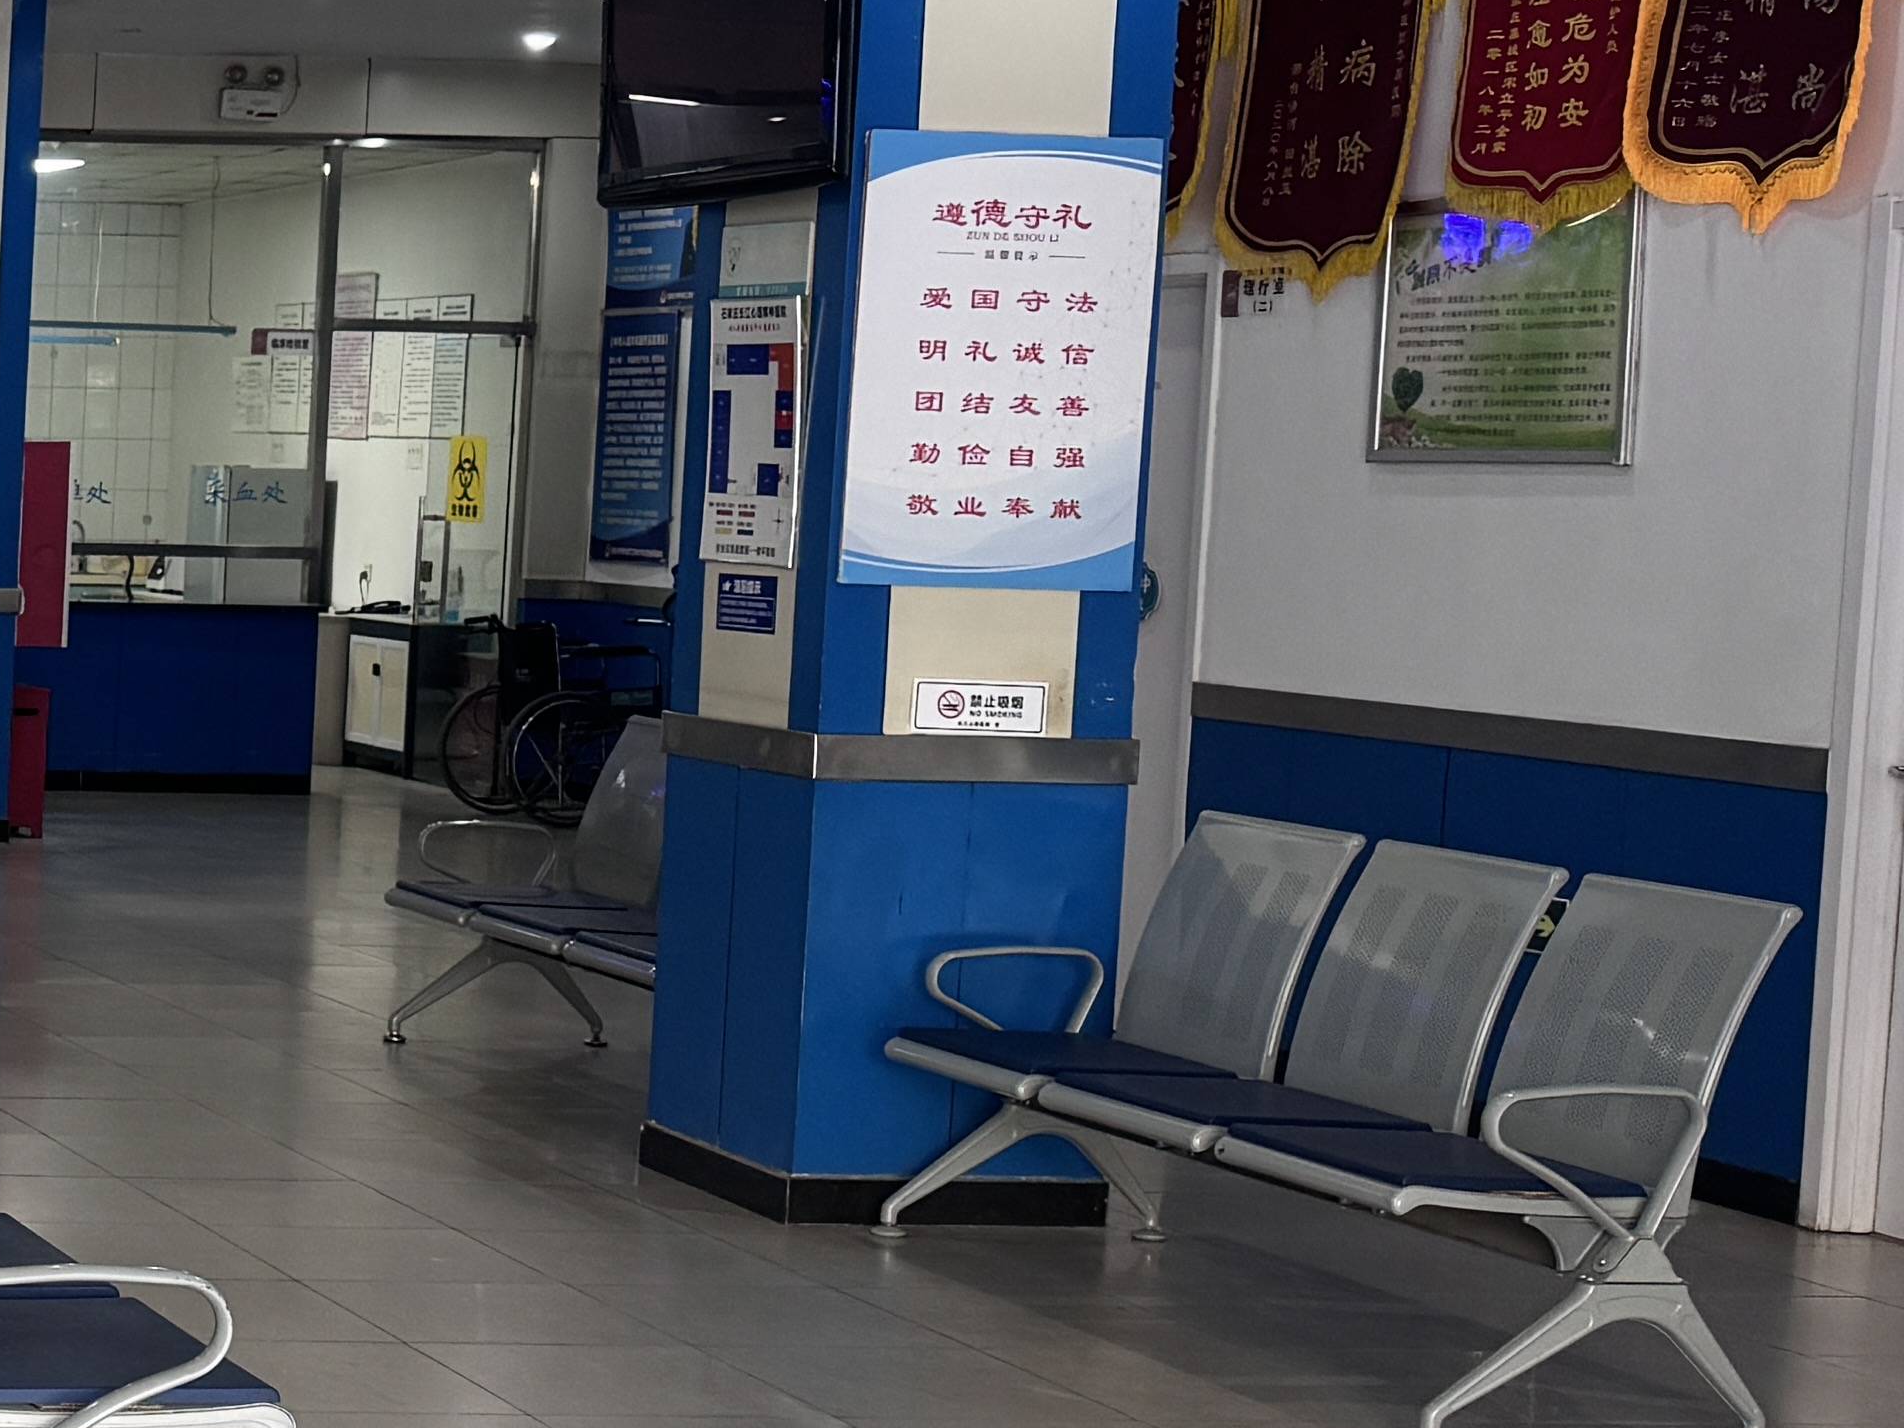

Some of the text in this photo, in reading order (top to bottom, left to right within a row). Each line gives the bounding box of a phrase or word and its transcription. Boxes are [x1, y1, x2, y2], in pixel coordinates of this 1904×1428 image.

[932, 198, 1092, 230] 遵德守礼
[920, 287, 1098, 313] 爱国守法
[919, 340, 1095, 365] 明礼诚信
[914, 391, 1090, 417] 团结友善
[909, 443, 1085, 468] 勤俭自强
[205, 469, 287, 506] 采血处
[906, 494, 1082, 519] 敬业奉献
[970, 694, 1024, 709] 禁止吸烟
